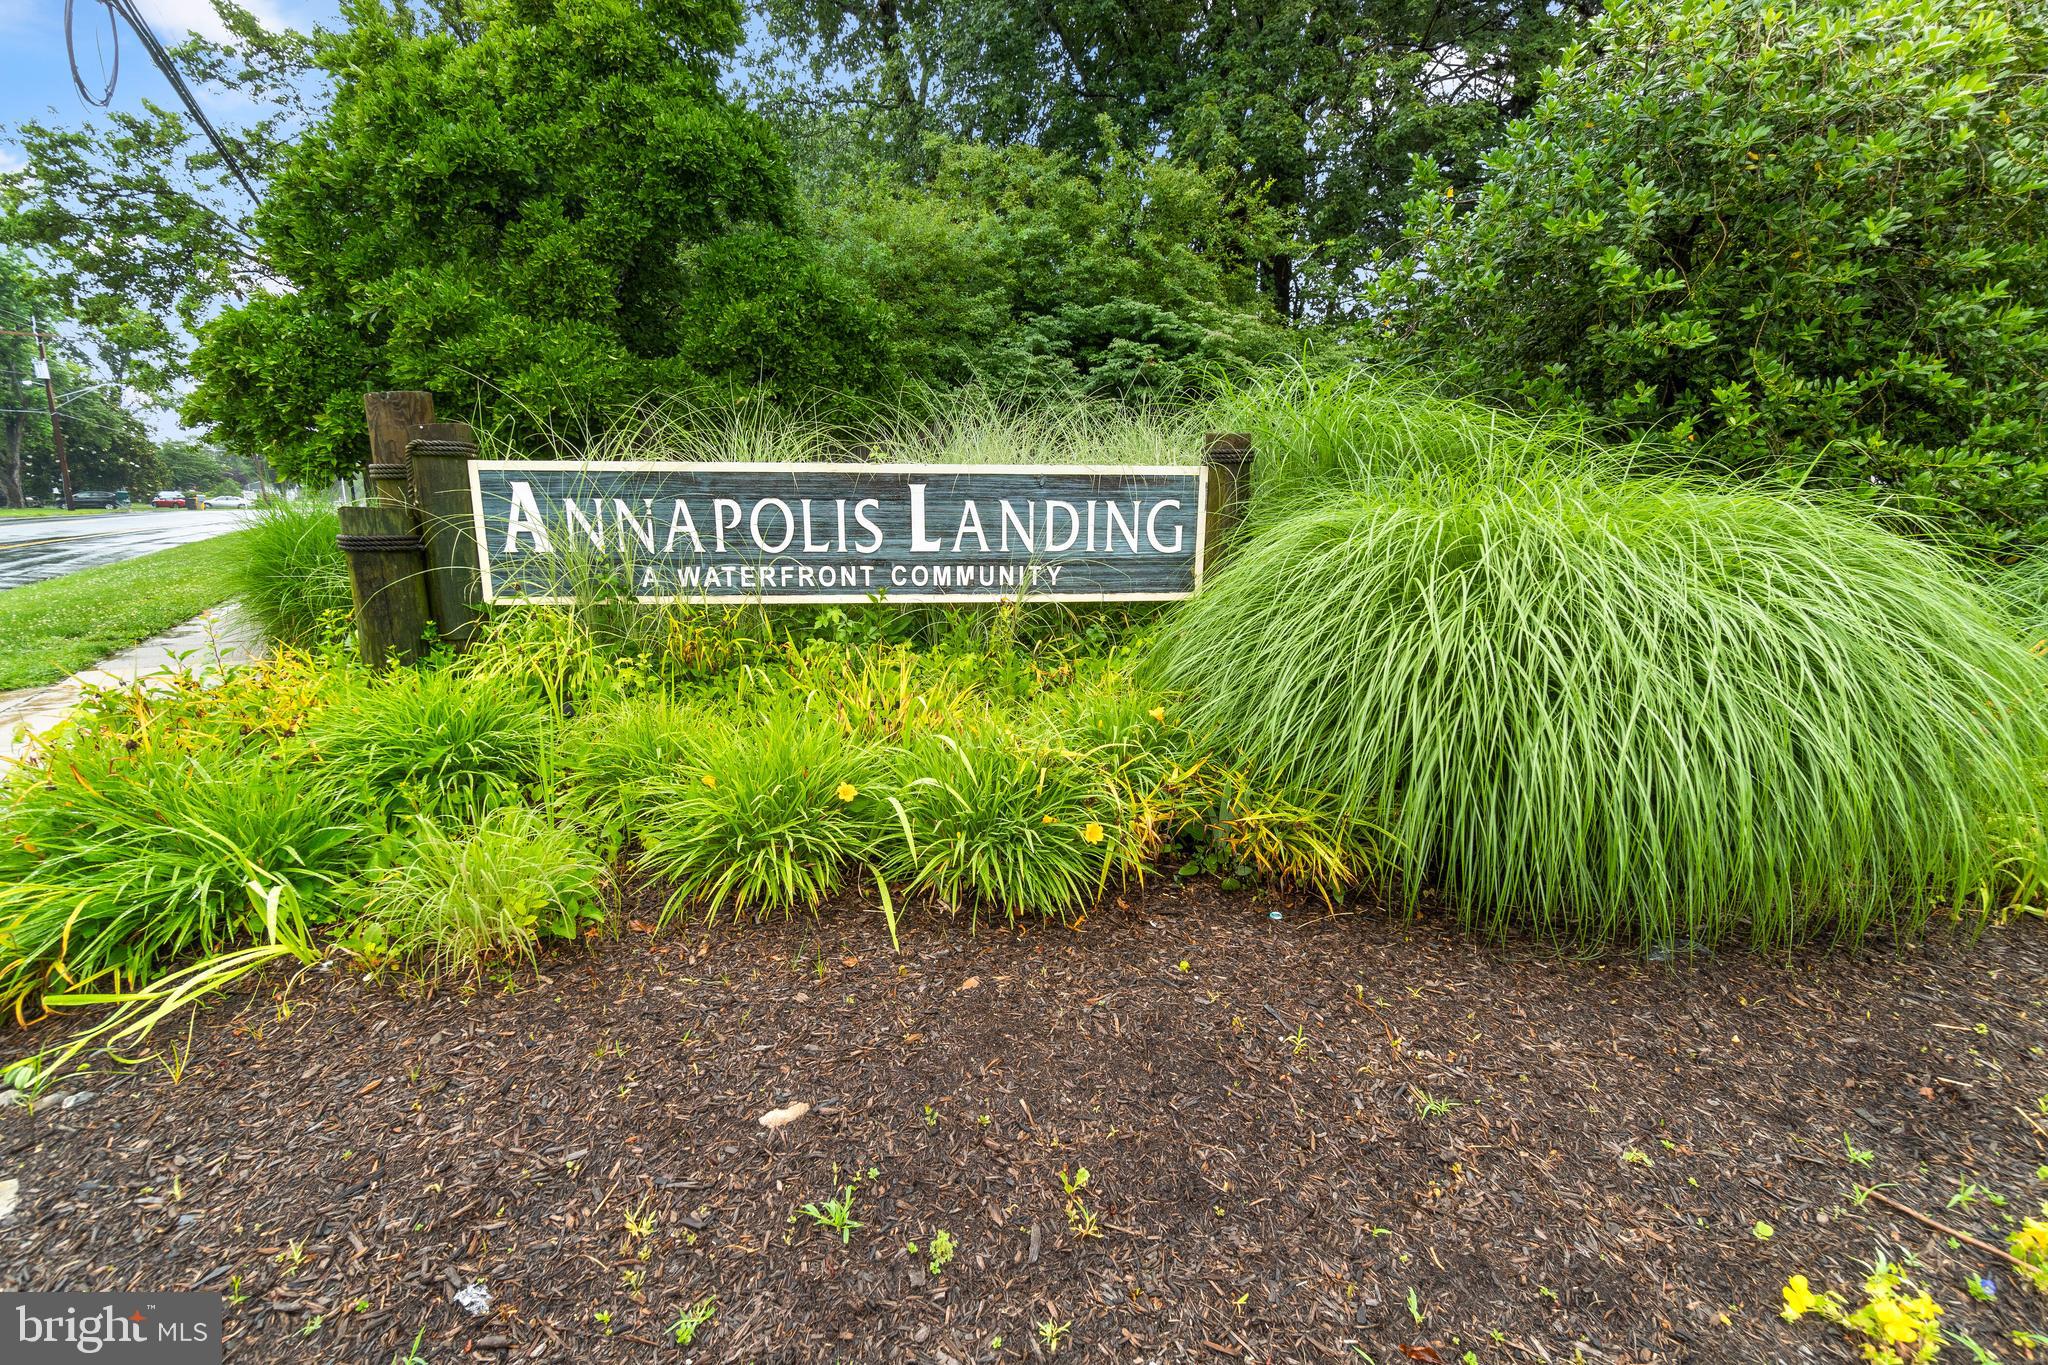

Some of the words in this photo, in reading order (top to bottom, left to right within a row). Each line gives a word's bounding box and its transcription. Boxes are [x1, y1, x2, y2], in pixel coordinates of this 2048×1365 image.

[501, 481, 883, 555] ANNAPOLIS
[908, 483, 1183, 555] LANDING
[642, 566, 660, 588] A
[677, 565, 875, 588] WATERFRONT
[891, 565, 1063, 588] COMMUNITY
